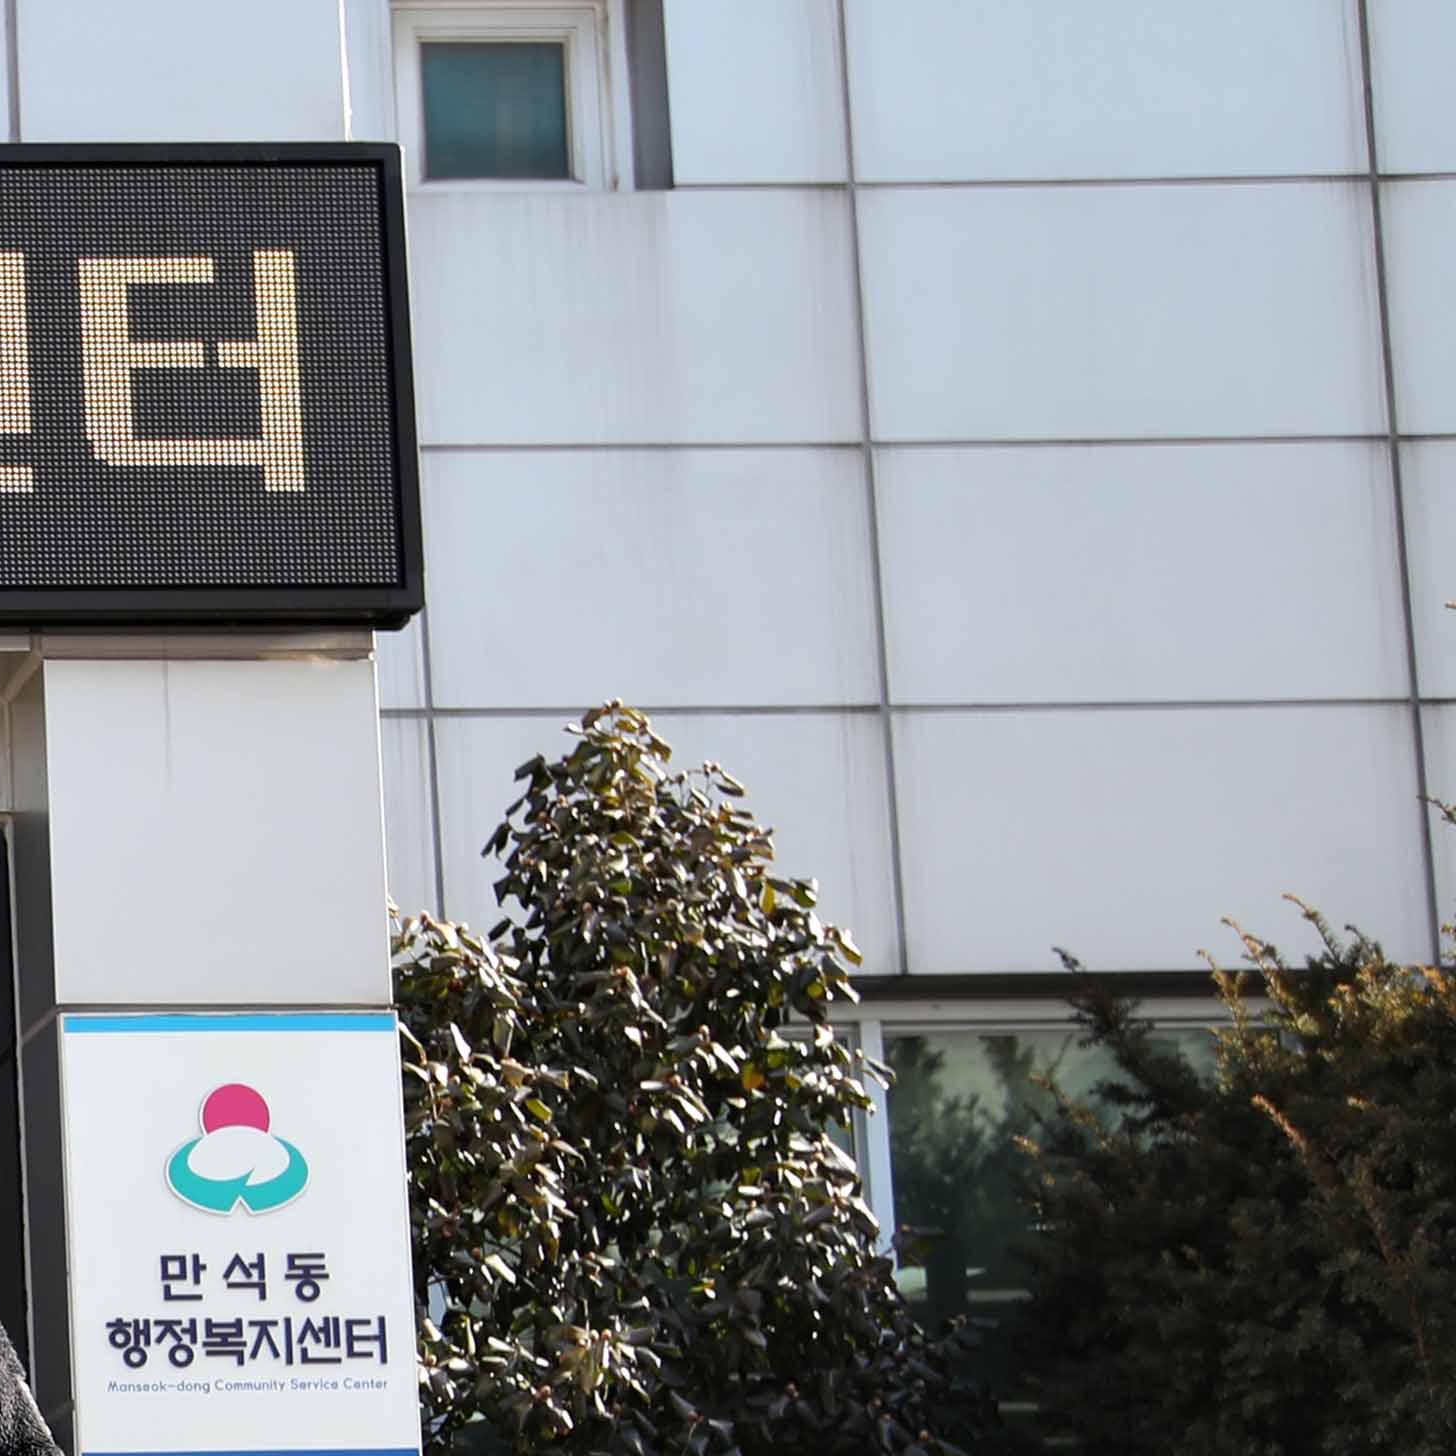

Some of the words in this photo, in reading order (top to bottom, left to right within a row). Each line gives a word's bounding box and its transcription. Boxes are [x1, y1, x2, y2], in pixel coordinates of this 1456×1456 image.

[160, 1252, 330, 1302] 만석동
[105, 1315, 389, 1369] 행정복지센터
[107, 1380, 210, 1394] Manseok-dong
[215, 1379, 285, 1393] Community
[290, 1377, 339, 1390] Service
[343, 1377, 388, 1390] Center
